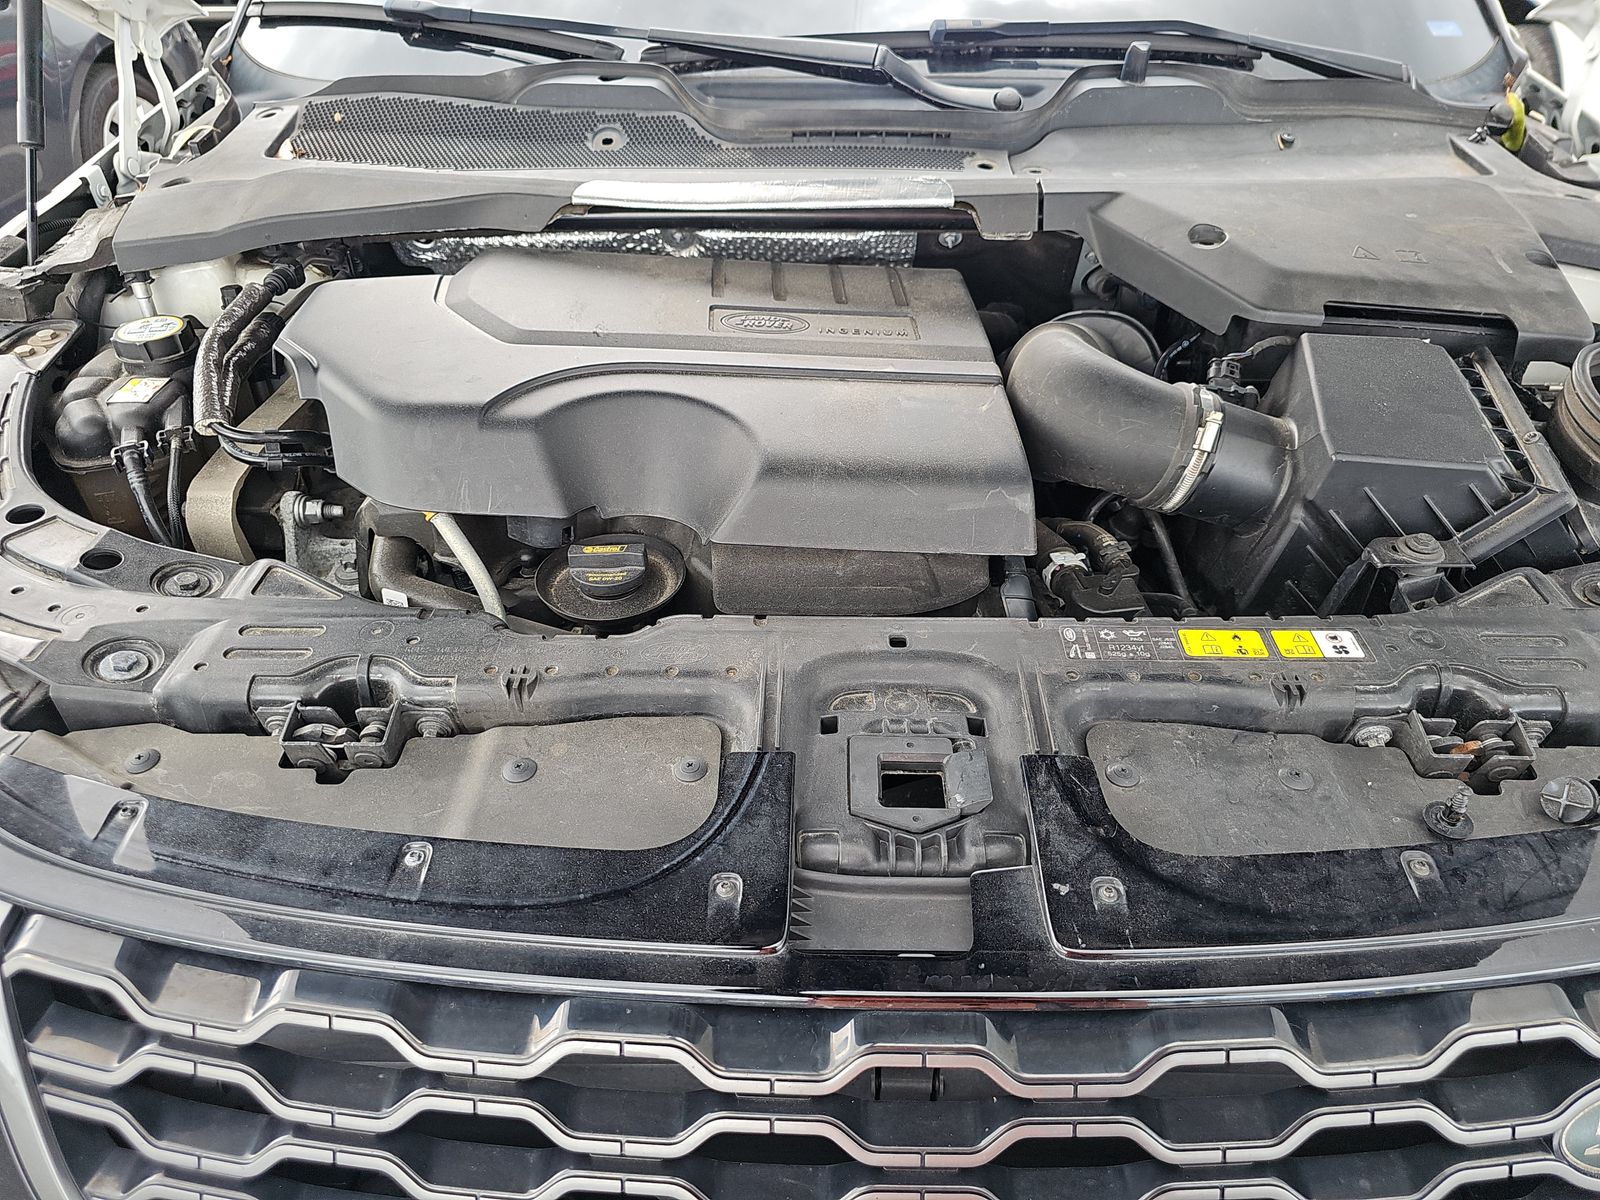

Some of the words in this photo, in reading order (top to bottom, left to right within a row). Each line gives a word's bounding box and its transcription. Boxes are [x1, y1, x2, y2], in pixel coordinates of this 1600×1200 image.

[743, 319, 794, 330] ROVER
[818, 327, 910, 337] INGENIUM
[592, 545, 619, 553] Castrol
[1108, 644, 1145, 652] R1234yf
